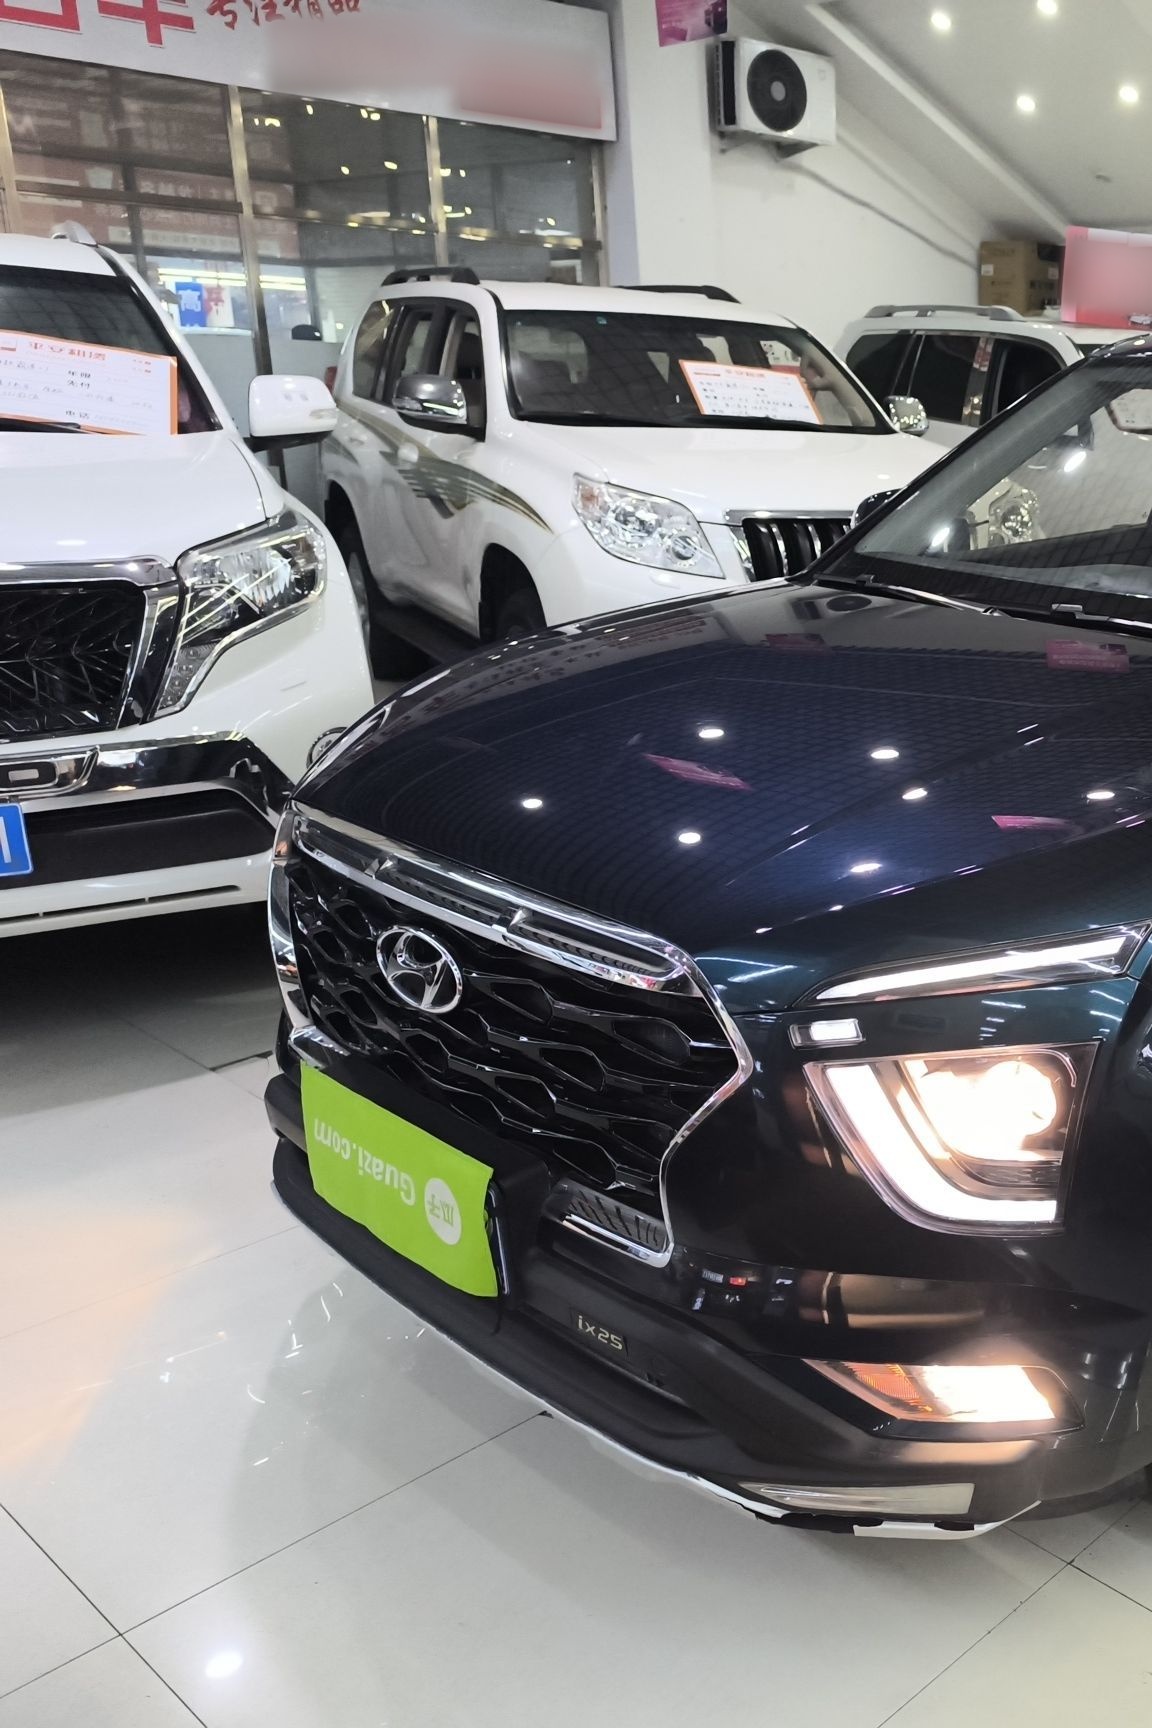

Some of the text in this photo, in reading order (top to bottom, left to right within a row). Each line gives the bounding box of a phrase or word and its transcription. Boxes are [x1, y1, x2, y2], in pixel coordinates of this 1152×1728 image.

[314, 1118, 416, 1206] Guazi.com
[427, 1193, 455, 1228] 瓜子
[578, 1315, 623, 1350] ix25
